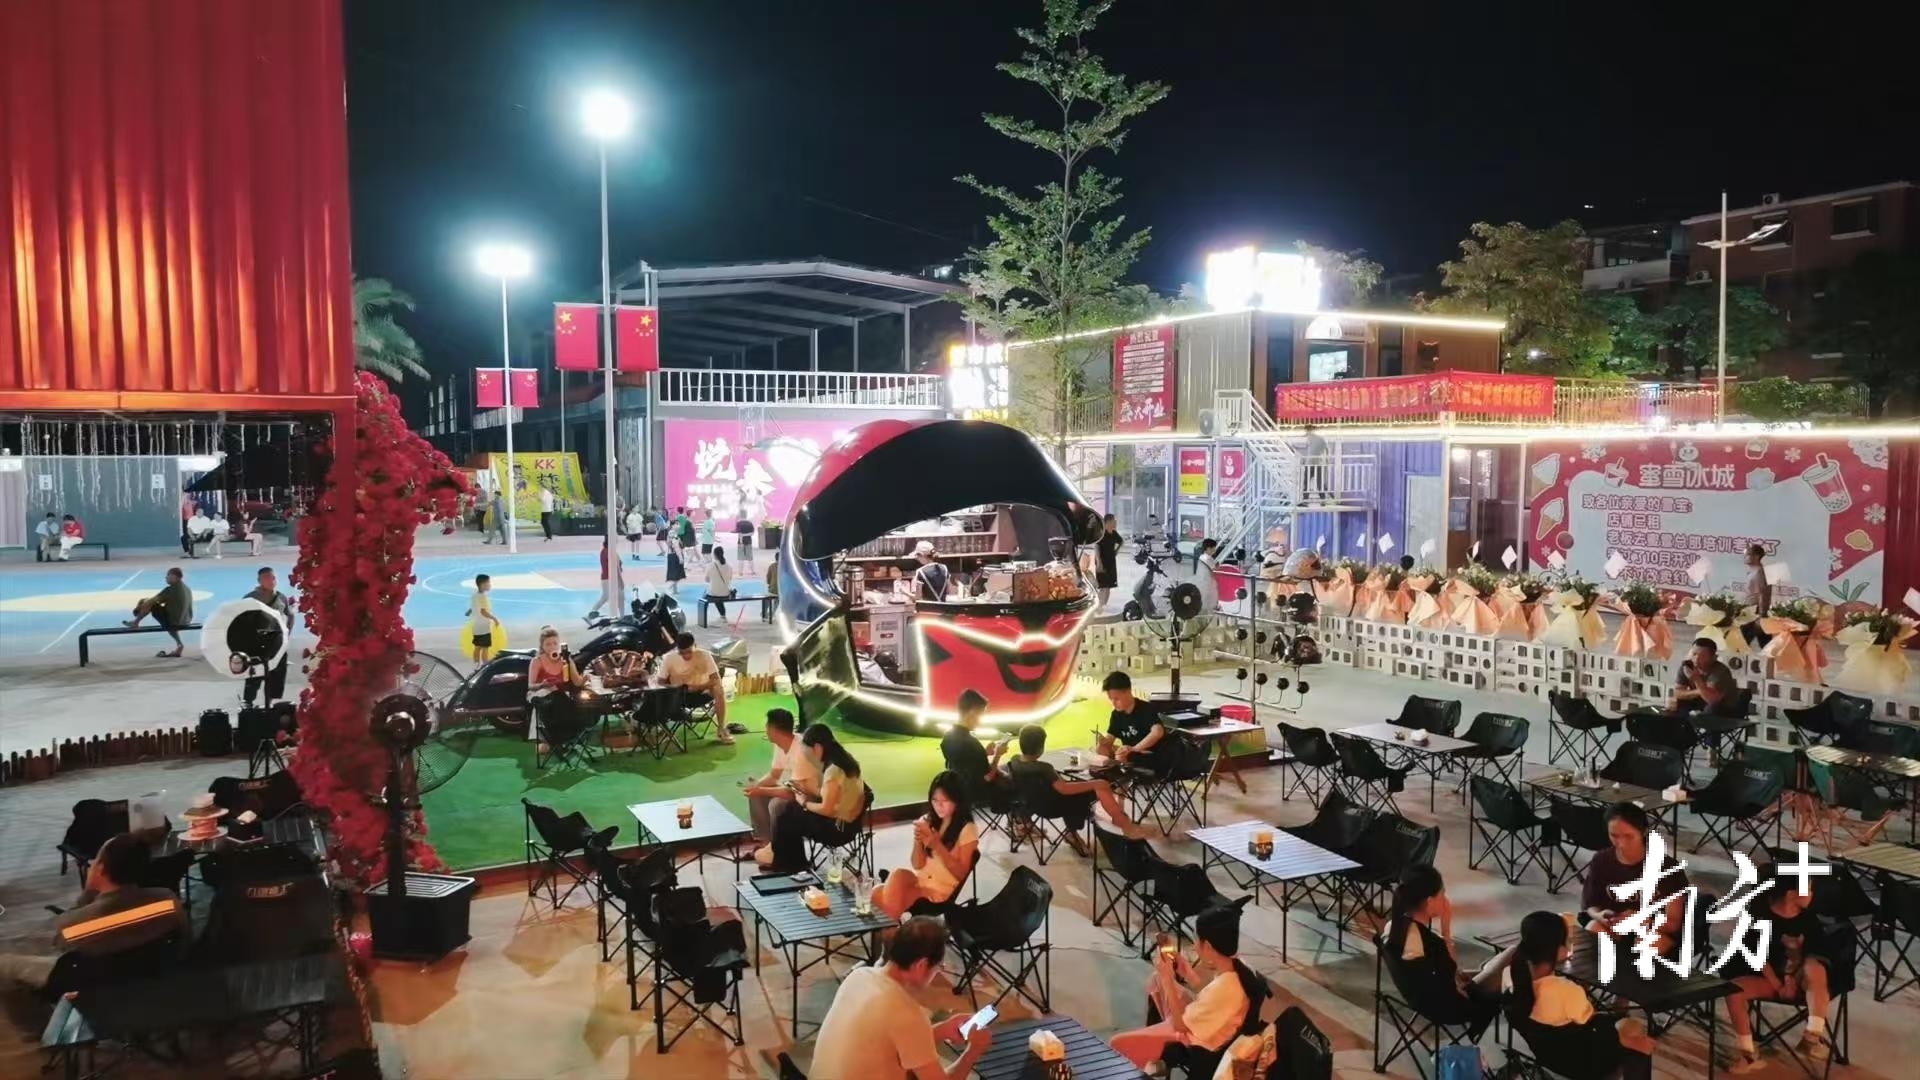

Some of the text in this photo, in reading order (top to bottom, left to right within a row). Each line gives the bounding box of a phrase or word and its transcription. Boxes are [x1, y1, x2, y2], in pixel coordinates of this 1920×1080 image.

[534, 458, 555, 470] KK
[1639, 463, 1735, 489] 蜜雪冰城
